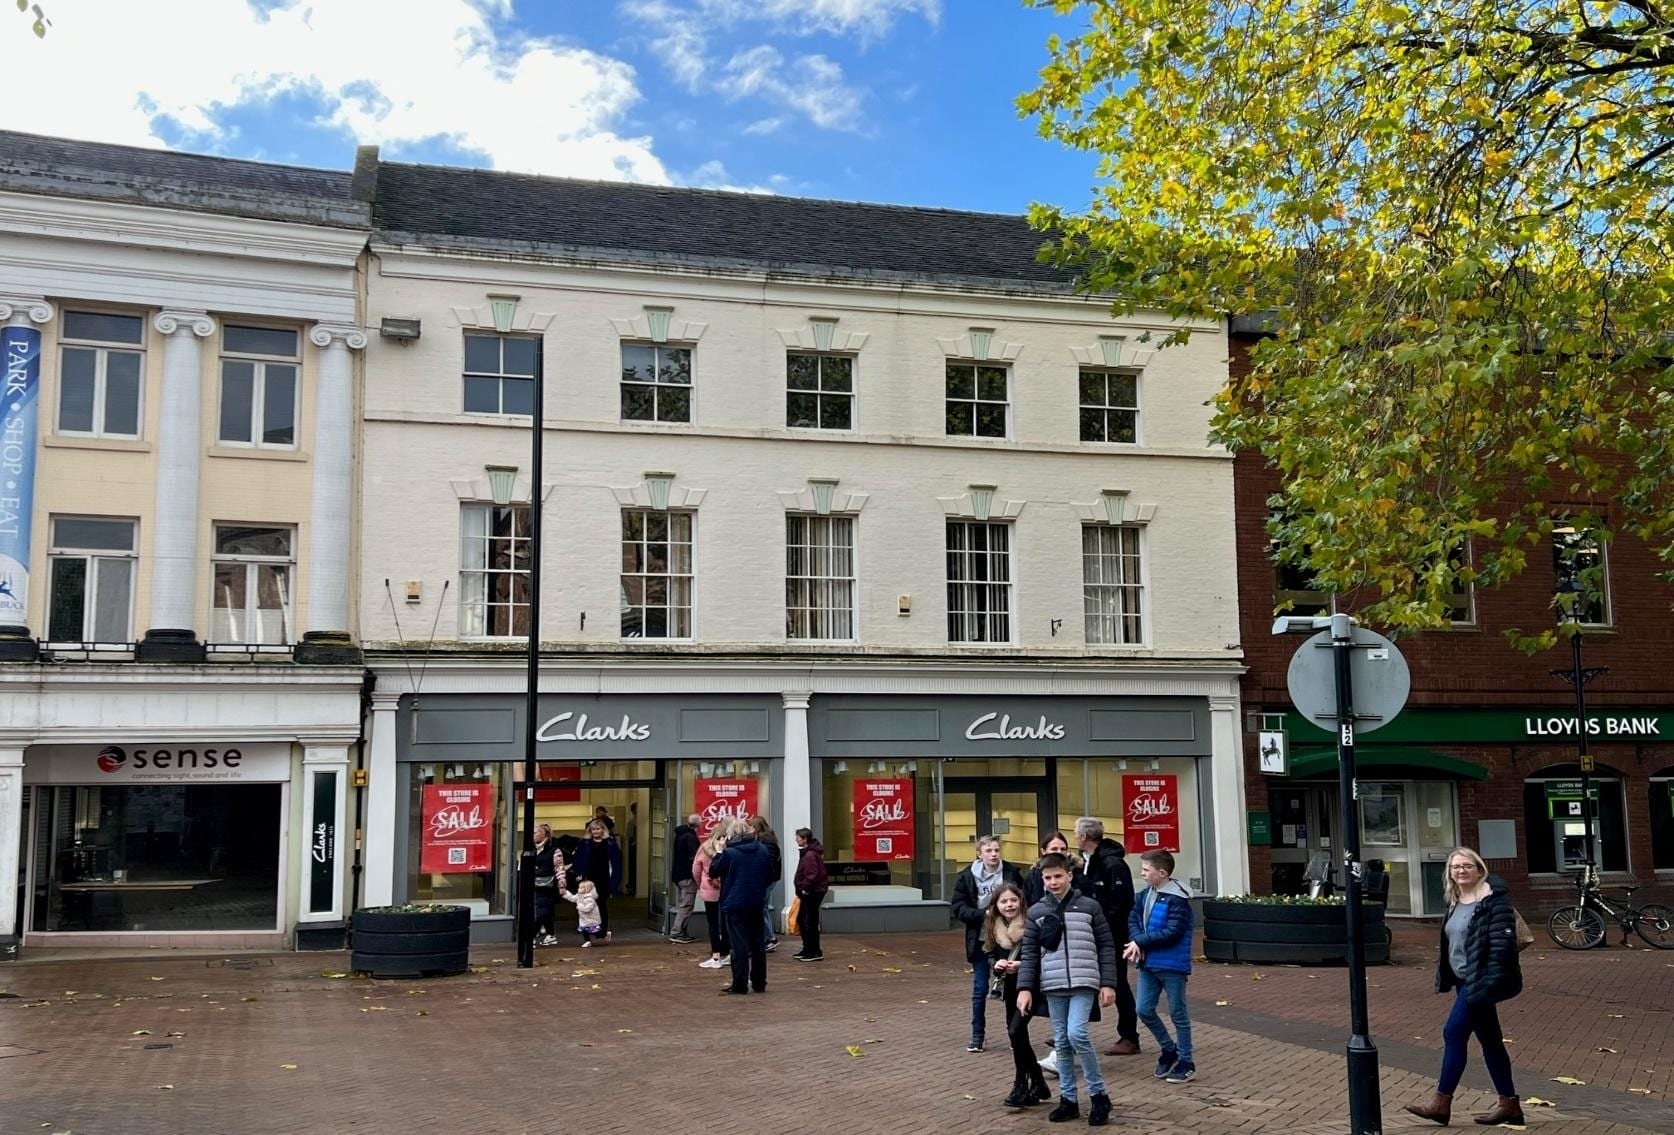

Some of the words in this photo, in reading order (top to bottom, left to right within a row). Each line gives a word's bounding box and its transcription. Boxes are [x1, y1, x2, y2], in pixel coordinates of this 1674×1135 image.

[7, 341, 28, 397] PARK
[3, 417, 24, 475] SHOP
[0, 496, 20, 539] EAT
[536, 711, 651, 742] Clarks
[965, 712, 1065, 740] Clarks
[1606, 717, 1660, 735] BANK
[133, 748, 242, 769] sense
[312, 822, 327, 863] Clarks
